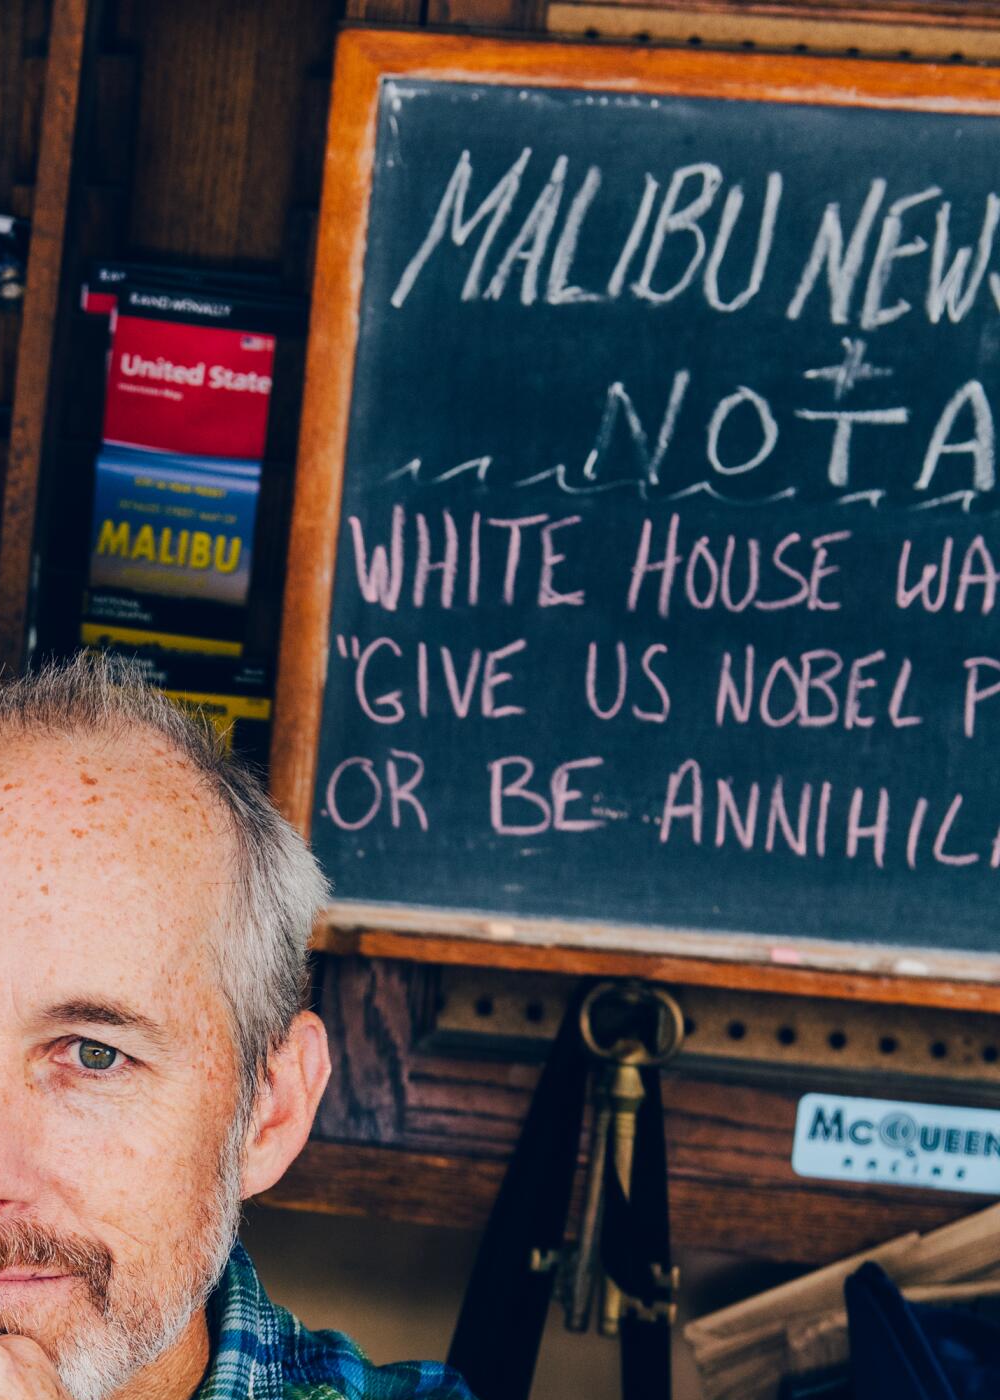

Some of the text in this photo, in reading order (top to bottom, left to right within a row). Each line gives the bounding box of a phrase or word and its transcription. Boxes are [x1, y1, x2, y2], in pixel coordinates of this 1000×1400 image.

[391, 147, 1000, 331] MALIBU NEW
[120, 352, 206, 387] United
[96, 518, 242, 575] MALIBU
[349, 504, 586, 612] WHITE
[626, 511, 853, 619] HOUSE
[585, 641, 671, 723] US
[715, 644, 924, 730] NOBEL
[326, 749, 1000, 869] OR BE ANNIHIL
